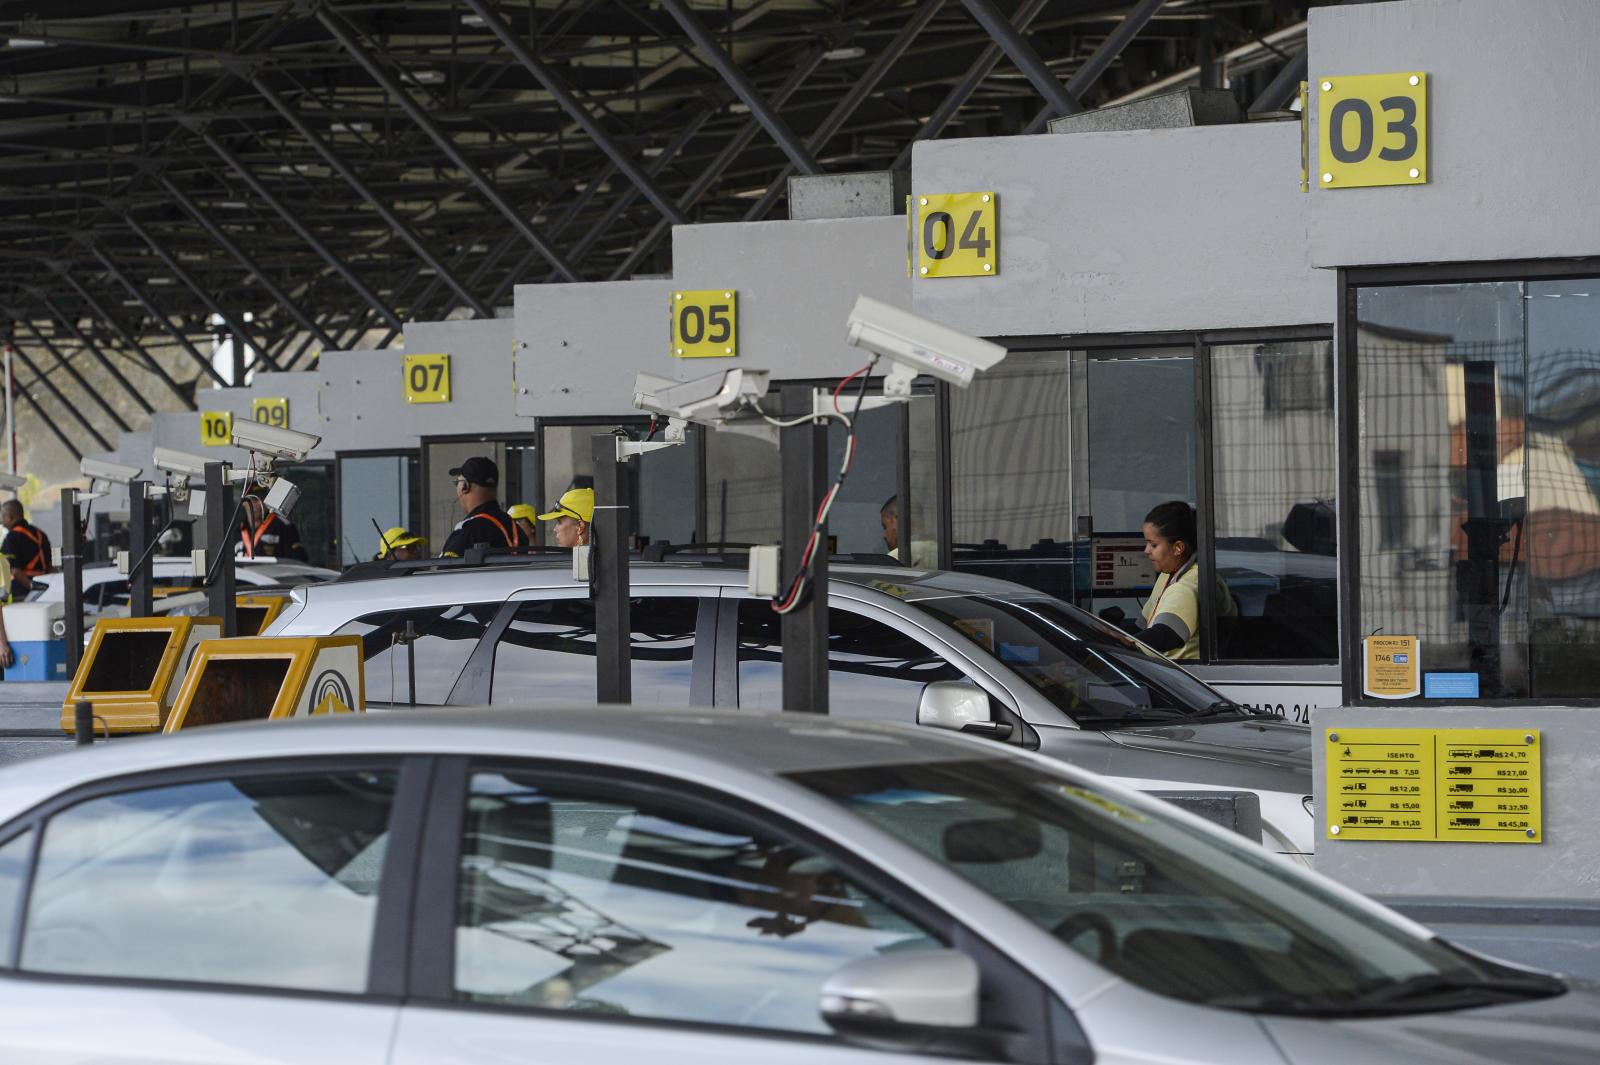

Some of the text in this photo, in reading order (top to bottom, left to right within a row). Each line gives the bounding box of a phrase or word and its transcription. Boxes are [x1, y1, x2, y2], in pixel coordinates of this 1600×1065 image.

[1329, 96, 1418, 163] 03
[924, 210, 991, 259] 04
[680, 305, 730, 344] 05
[411, 364, 444, 392] 07
[205, 418, 226, 438] 10
[256, 406, 284, 426] 09
